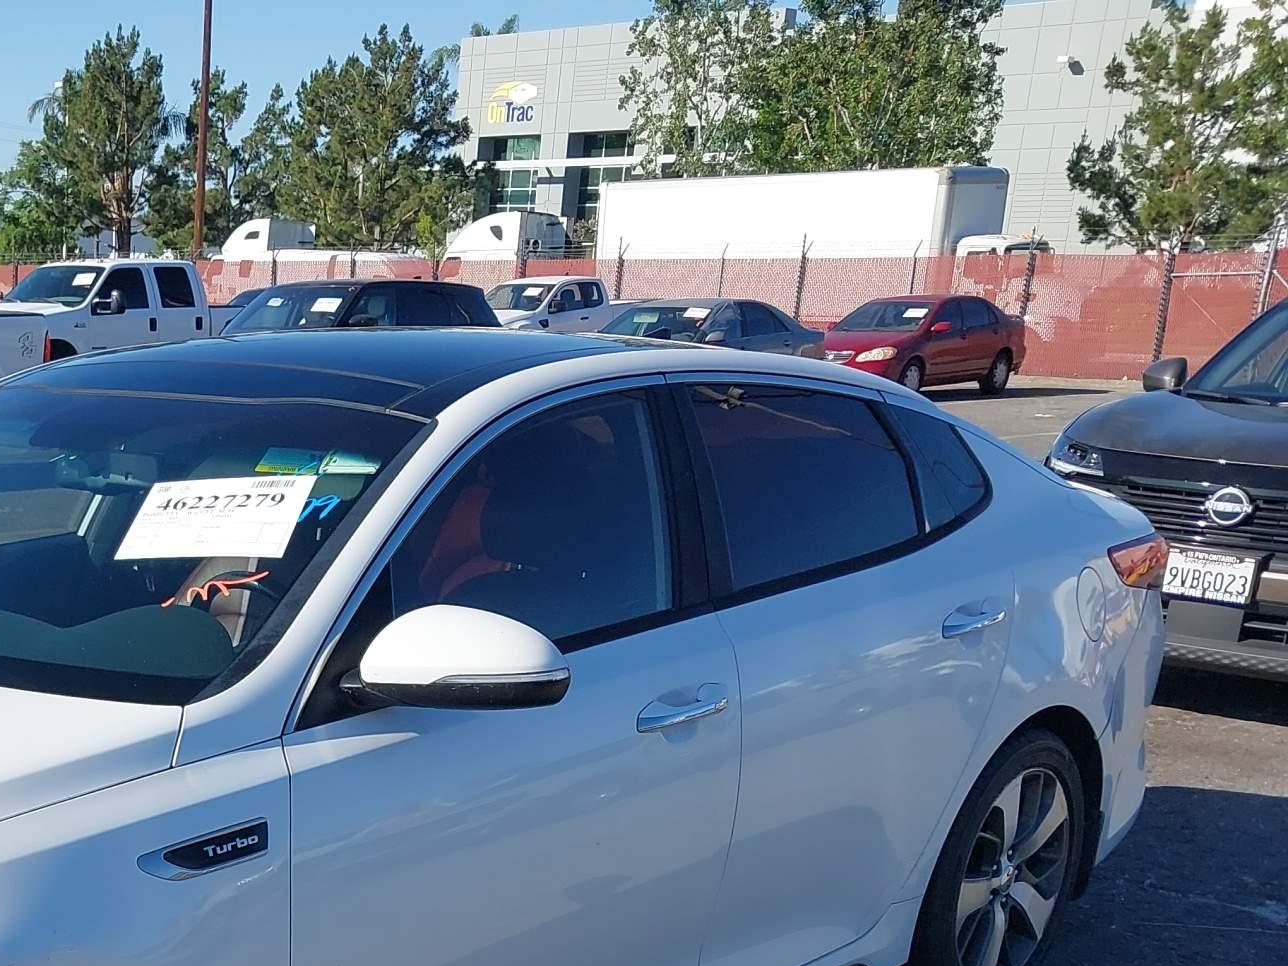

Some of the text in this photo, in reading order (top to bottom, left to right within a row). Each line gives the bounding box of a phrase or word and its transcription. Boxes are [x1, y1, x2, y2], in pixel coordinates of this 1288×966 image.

[488, 102, 533, 123] OnTrac
[157, 493, 286, 511] 46227279
[1205, 501, 1253, 513] NISSAN
[1167, 566, 1248, 595] 9VBG023
[1163, 586, 1246, 604] EMPIRE NISSAN
[203, 835, 259, 857] Turbo
